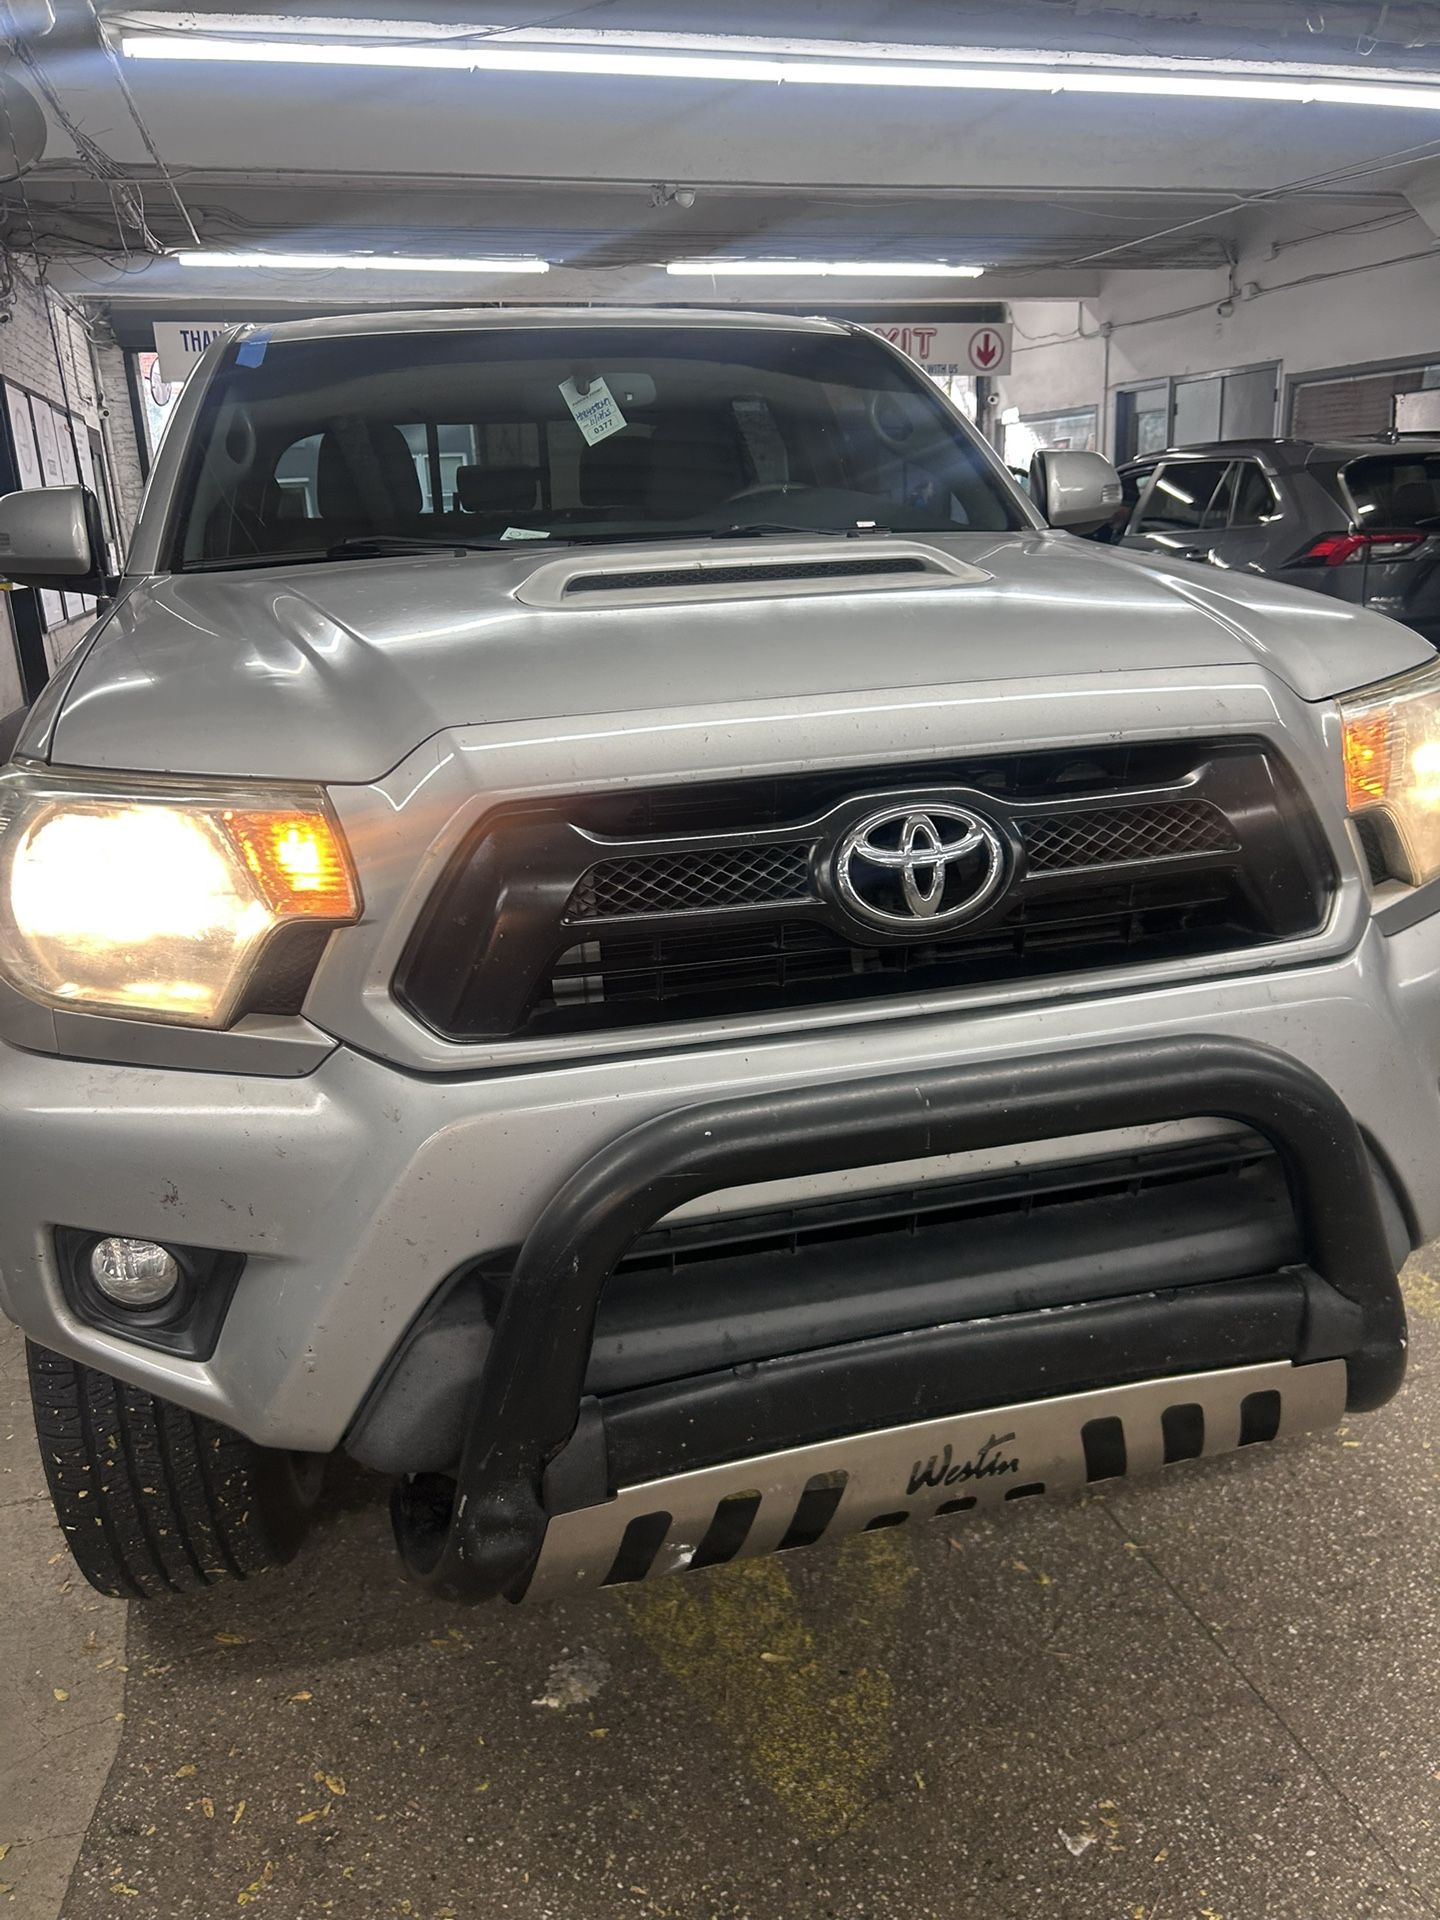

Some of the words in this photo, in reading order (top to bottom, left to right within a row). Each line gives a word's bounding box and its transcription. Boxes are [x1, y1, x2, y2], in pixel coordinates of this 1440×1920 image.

[927, 363, 948, 374] WITH
[948, 363, 959, 374] US
[593, 419, 613, 434] 0377
[906, 1432, 1020, 1495] Westin
